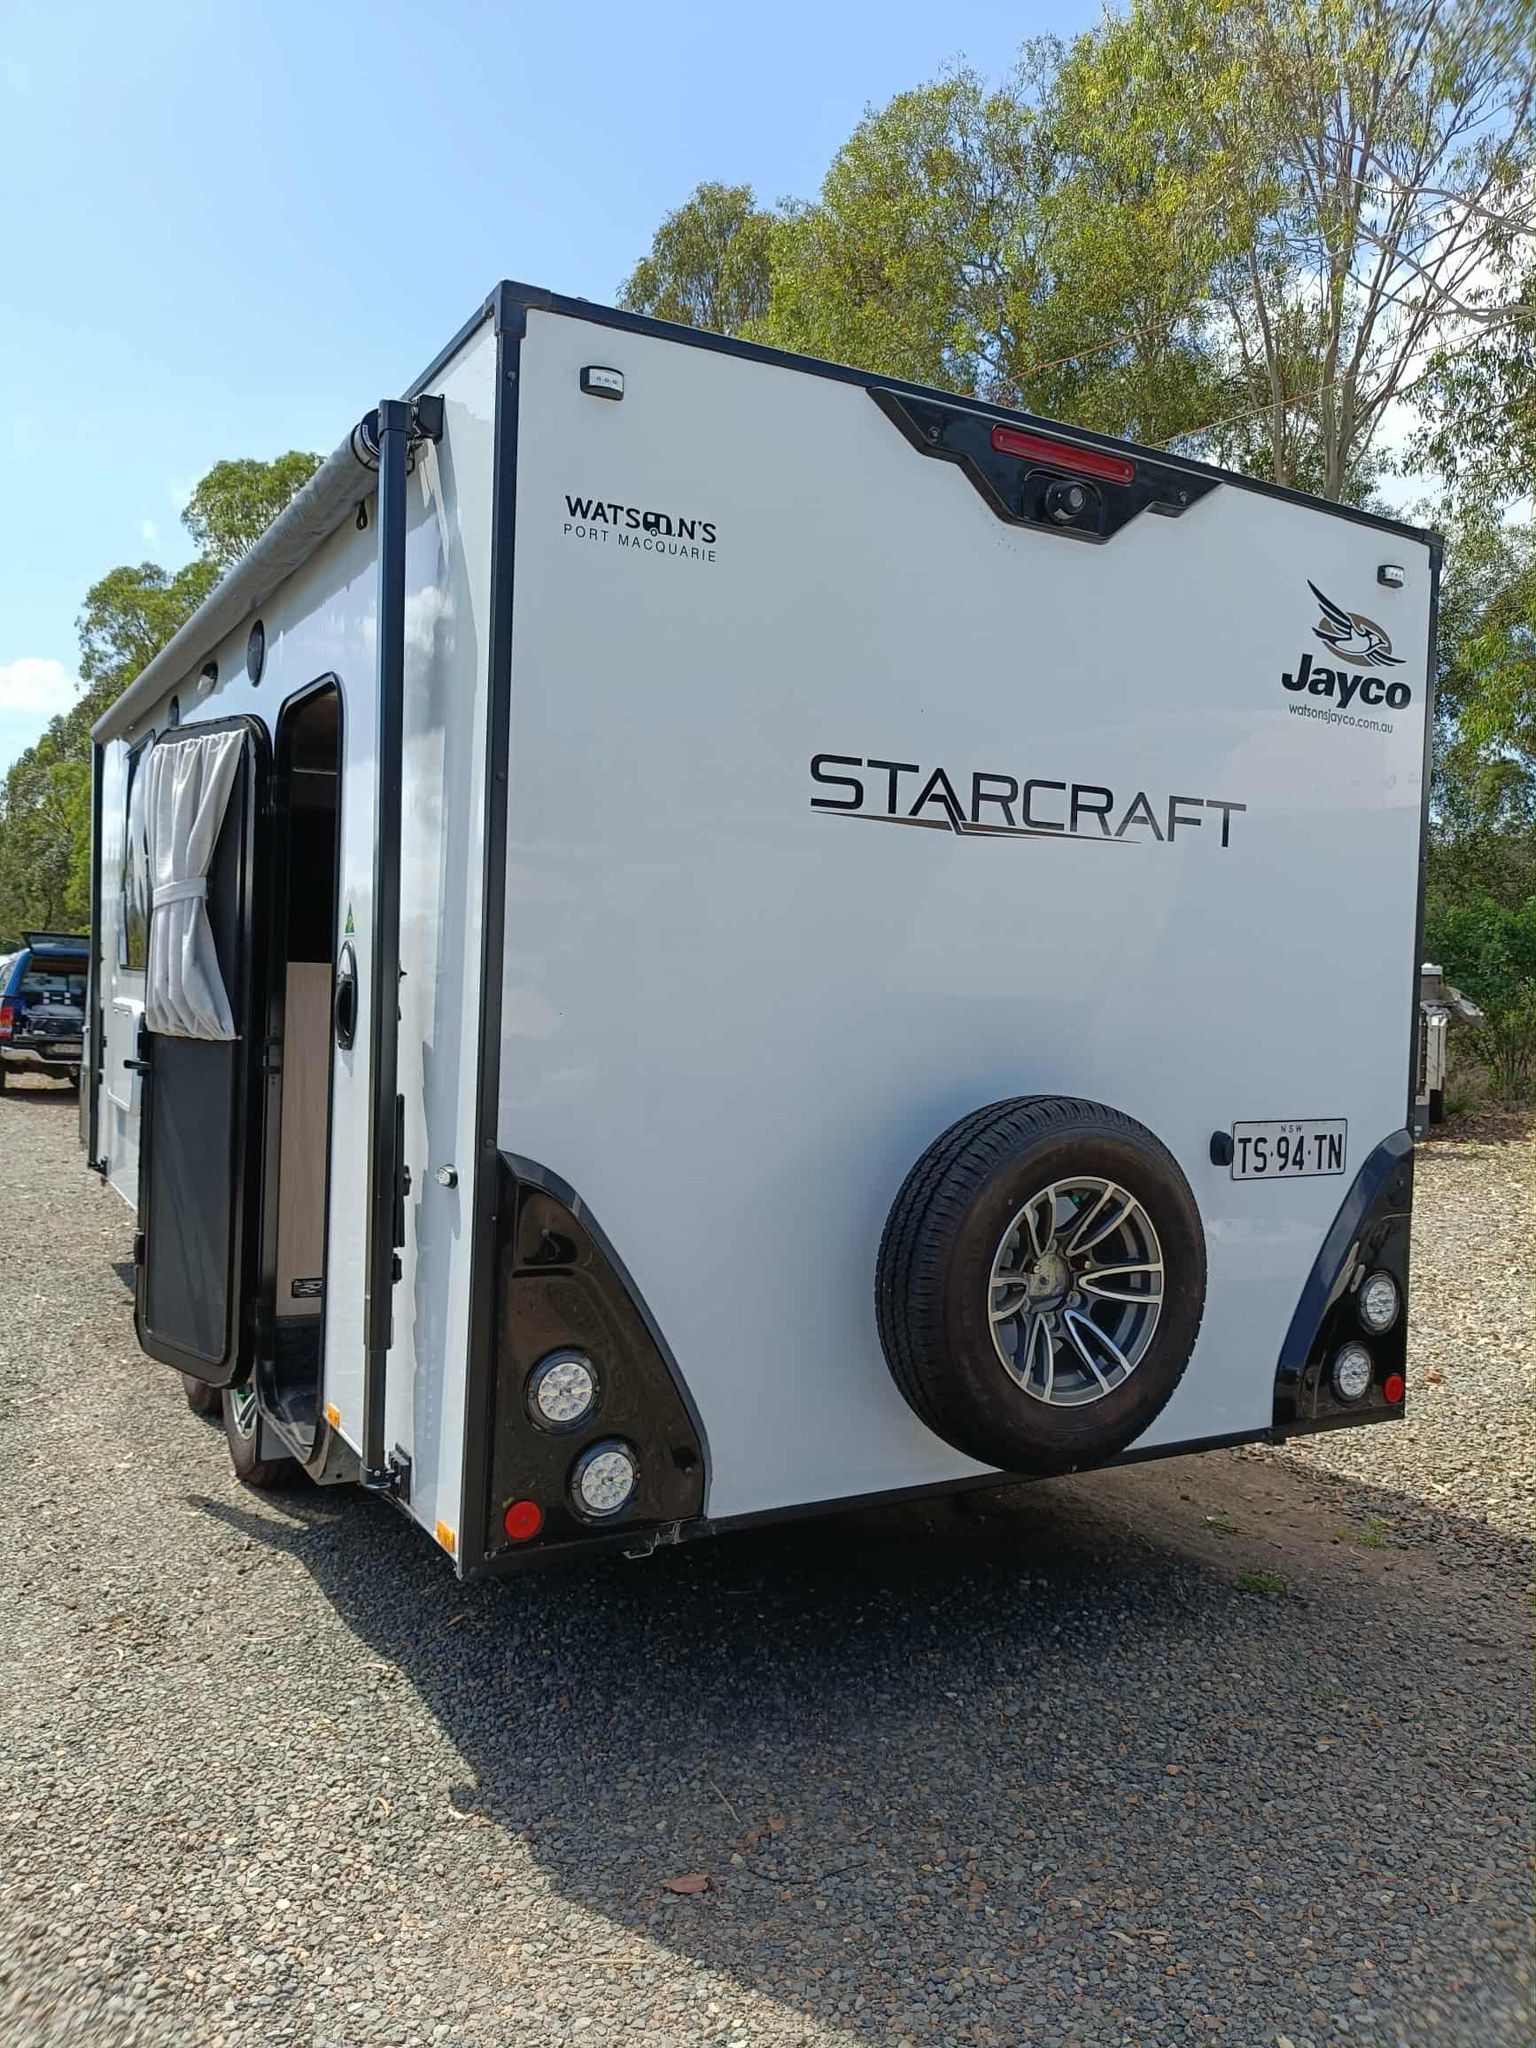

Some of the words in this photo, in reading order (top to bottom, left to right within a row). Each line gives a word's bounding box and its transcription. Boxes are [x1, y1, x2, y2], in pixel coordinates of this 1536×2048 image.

[563, 523, 609, 542] PORT
[618, 533, 717, 562] MACQUARIE
[1281, 653, 1412, 710] Jayco
[1288, 703, 1394, 734] watsonsjayco.com.au
[810, 753, 1247, 848] STARCRAFT
[1280, 1125, 1302, 1133] NSW
